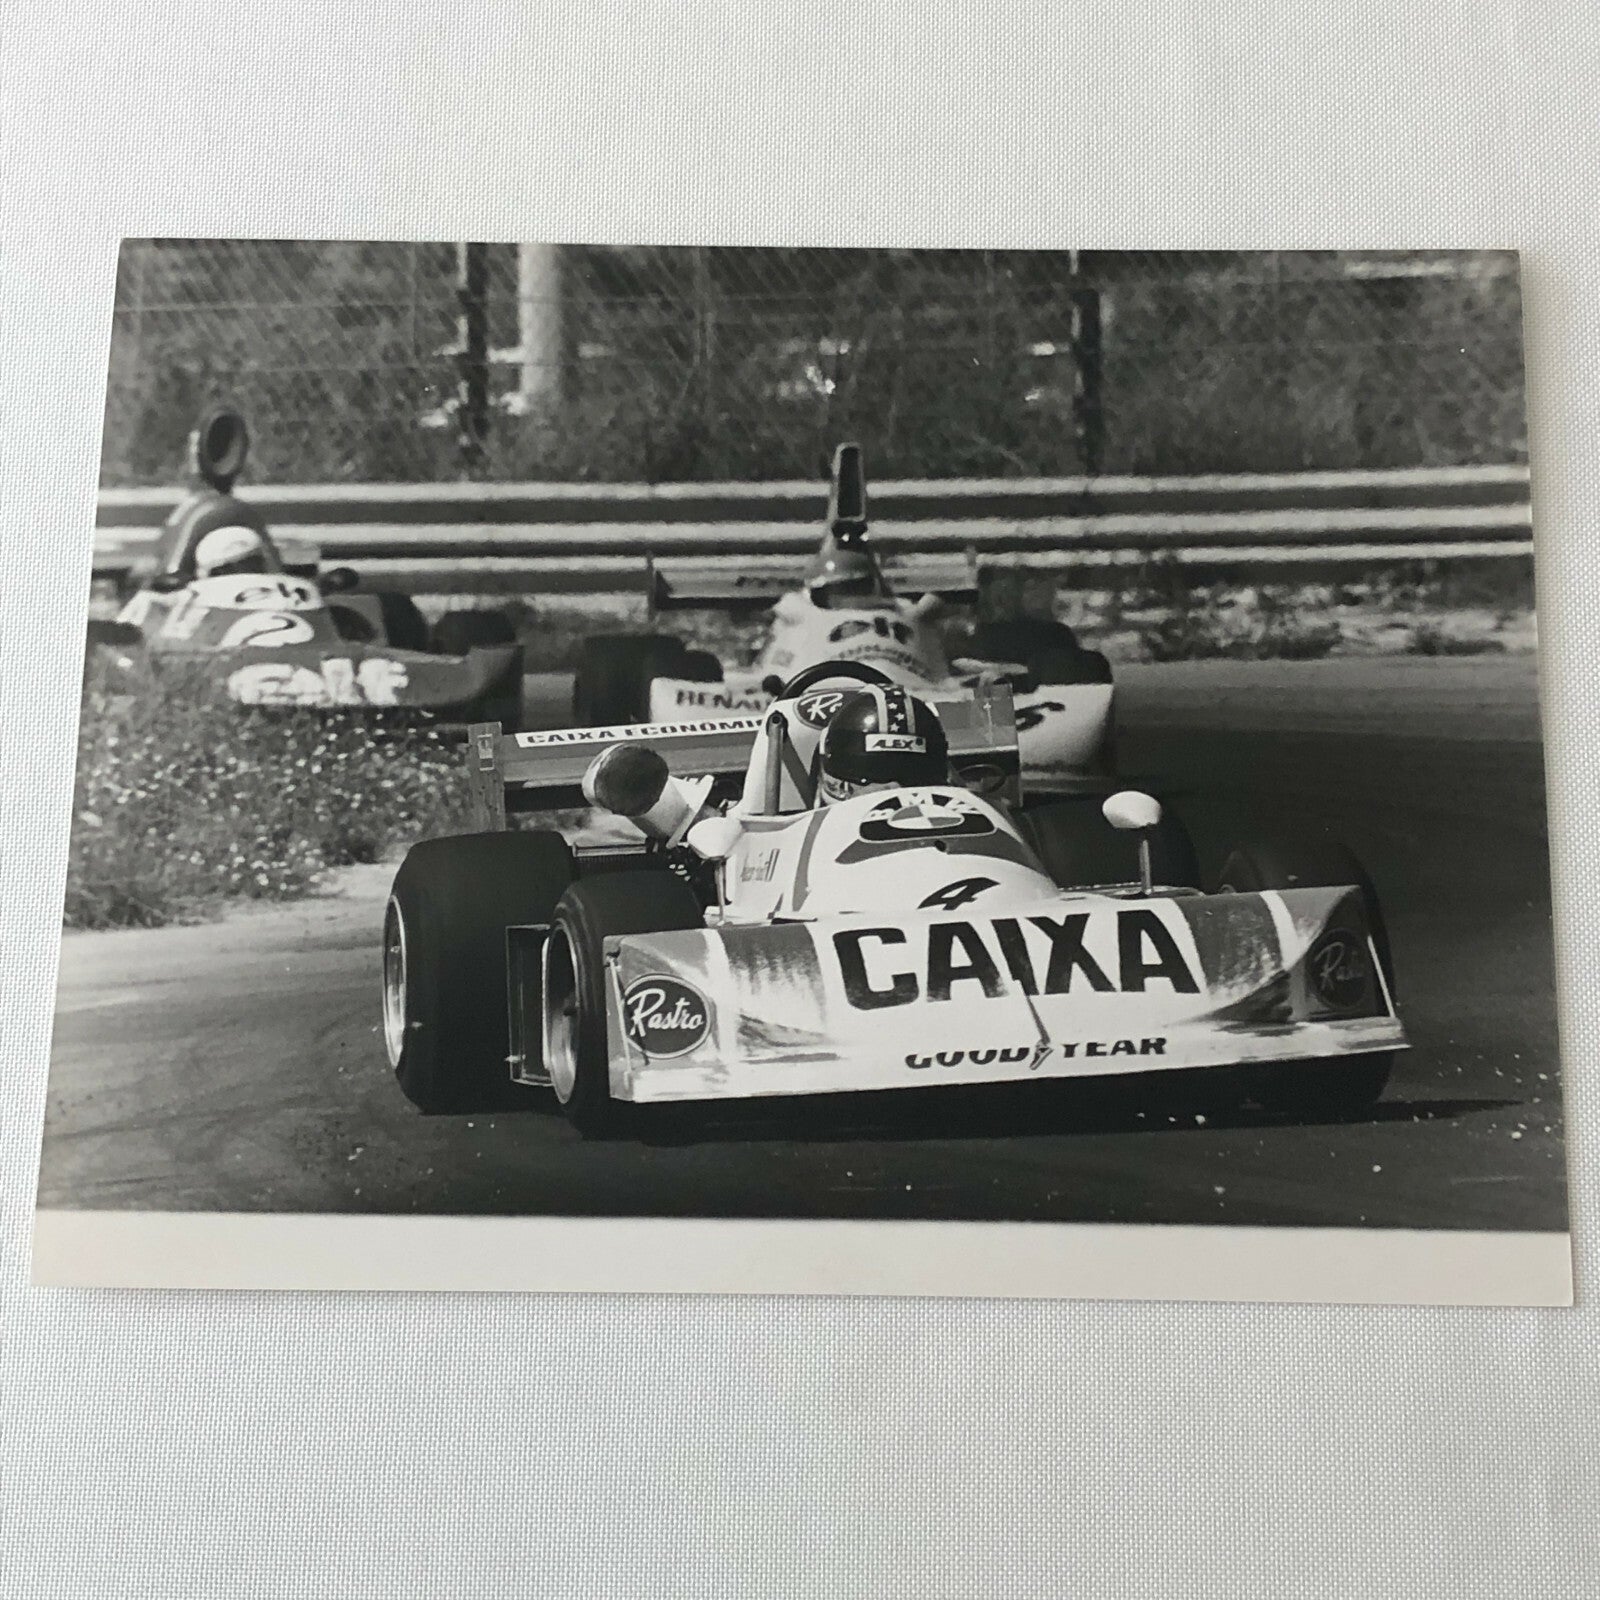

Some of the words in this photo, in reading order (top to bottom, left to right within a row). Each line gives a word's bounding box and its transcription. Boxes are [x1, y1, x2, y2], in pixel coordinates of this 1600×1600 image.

[676, 689, 772, 711] RENAU
[526, 730, 615, 744] CAIXA
[872, 738, 914, 751] ALEX
[917, 876, 1001, 911] 4
[832, 909, 1202, 1011] CAIXA
[626, 987, 704, 1037] Rastro
[1061, 1036, 1168, 1059] YEAR
